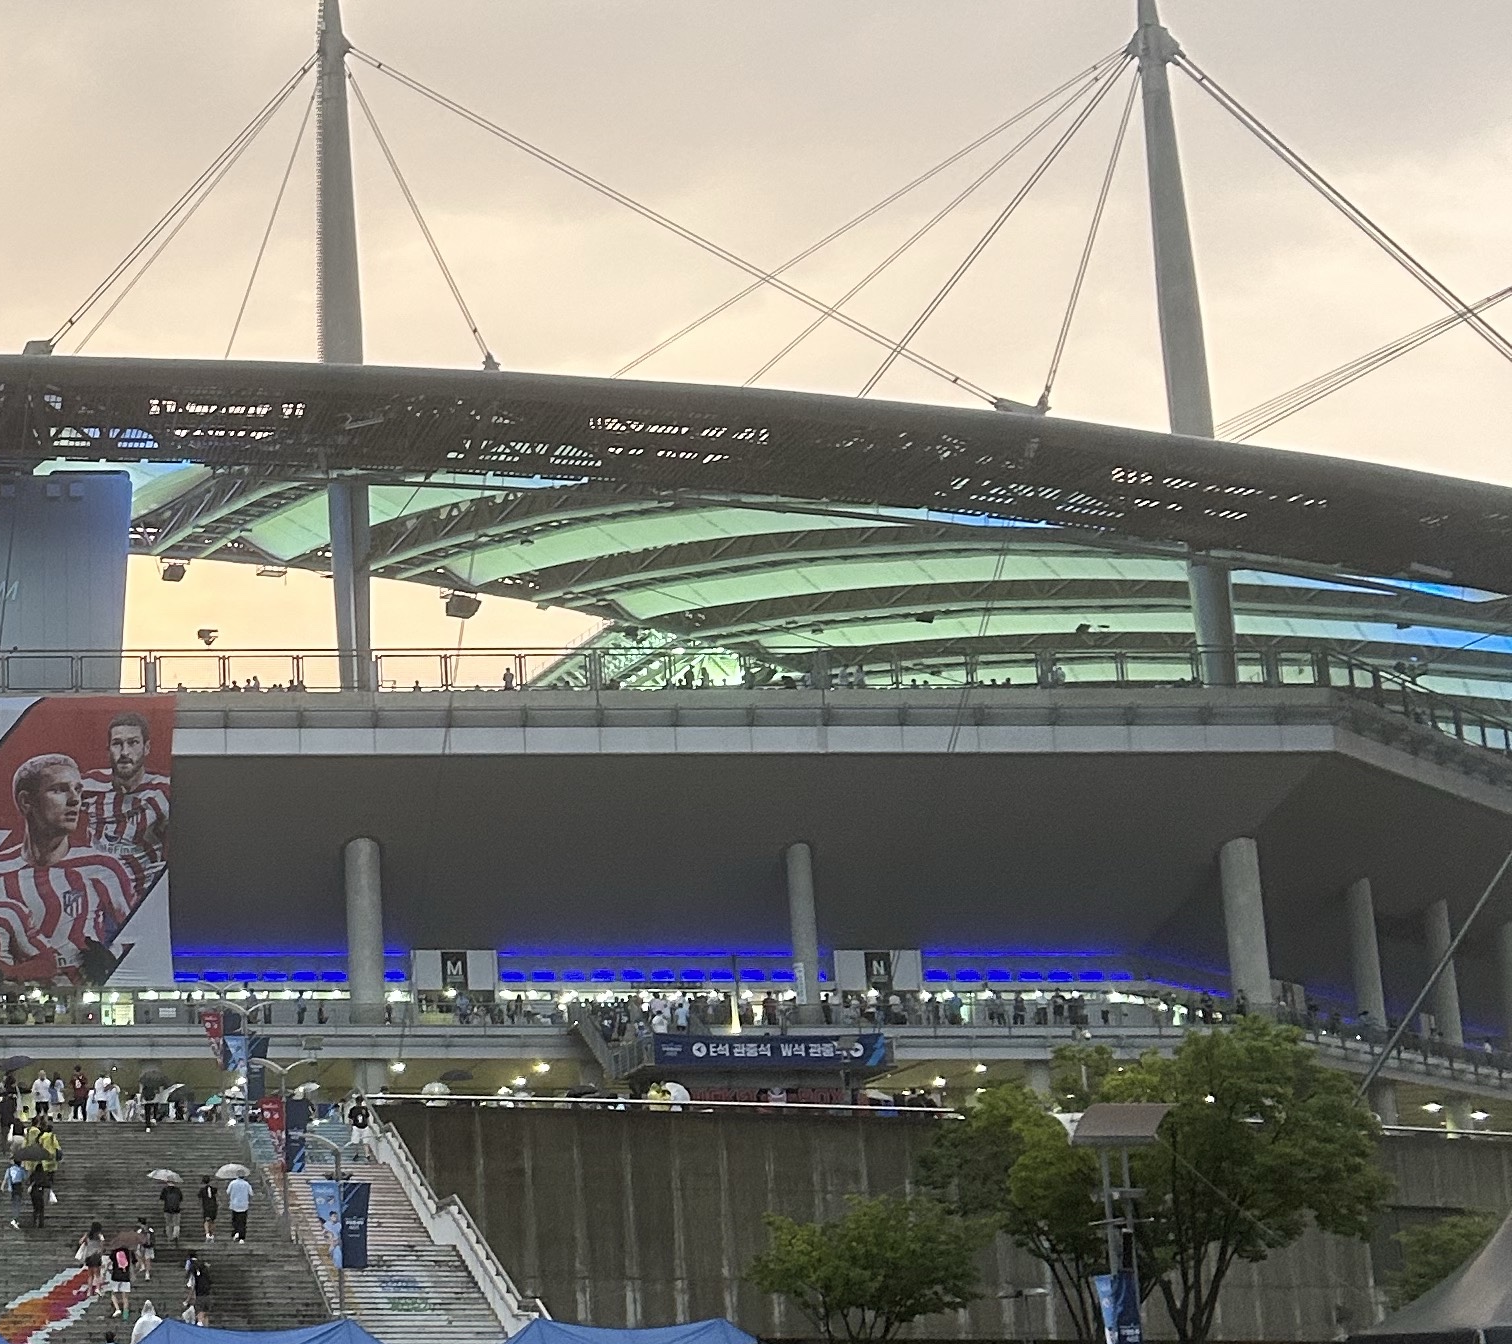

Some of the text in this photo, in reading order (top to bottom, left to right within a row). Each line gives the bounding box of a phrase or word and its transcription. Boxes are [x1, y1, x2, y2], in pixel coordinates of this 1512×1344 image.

[447, 960, 463, 976] M
[872, 959, 885, 975] N
[709, 1042, 730, 1057] E석
[781, 1042, 806, 1058] W석
